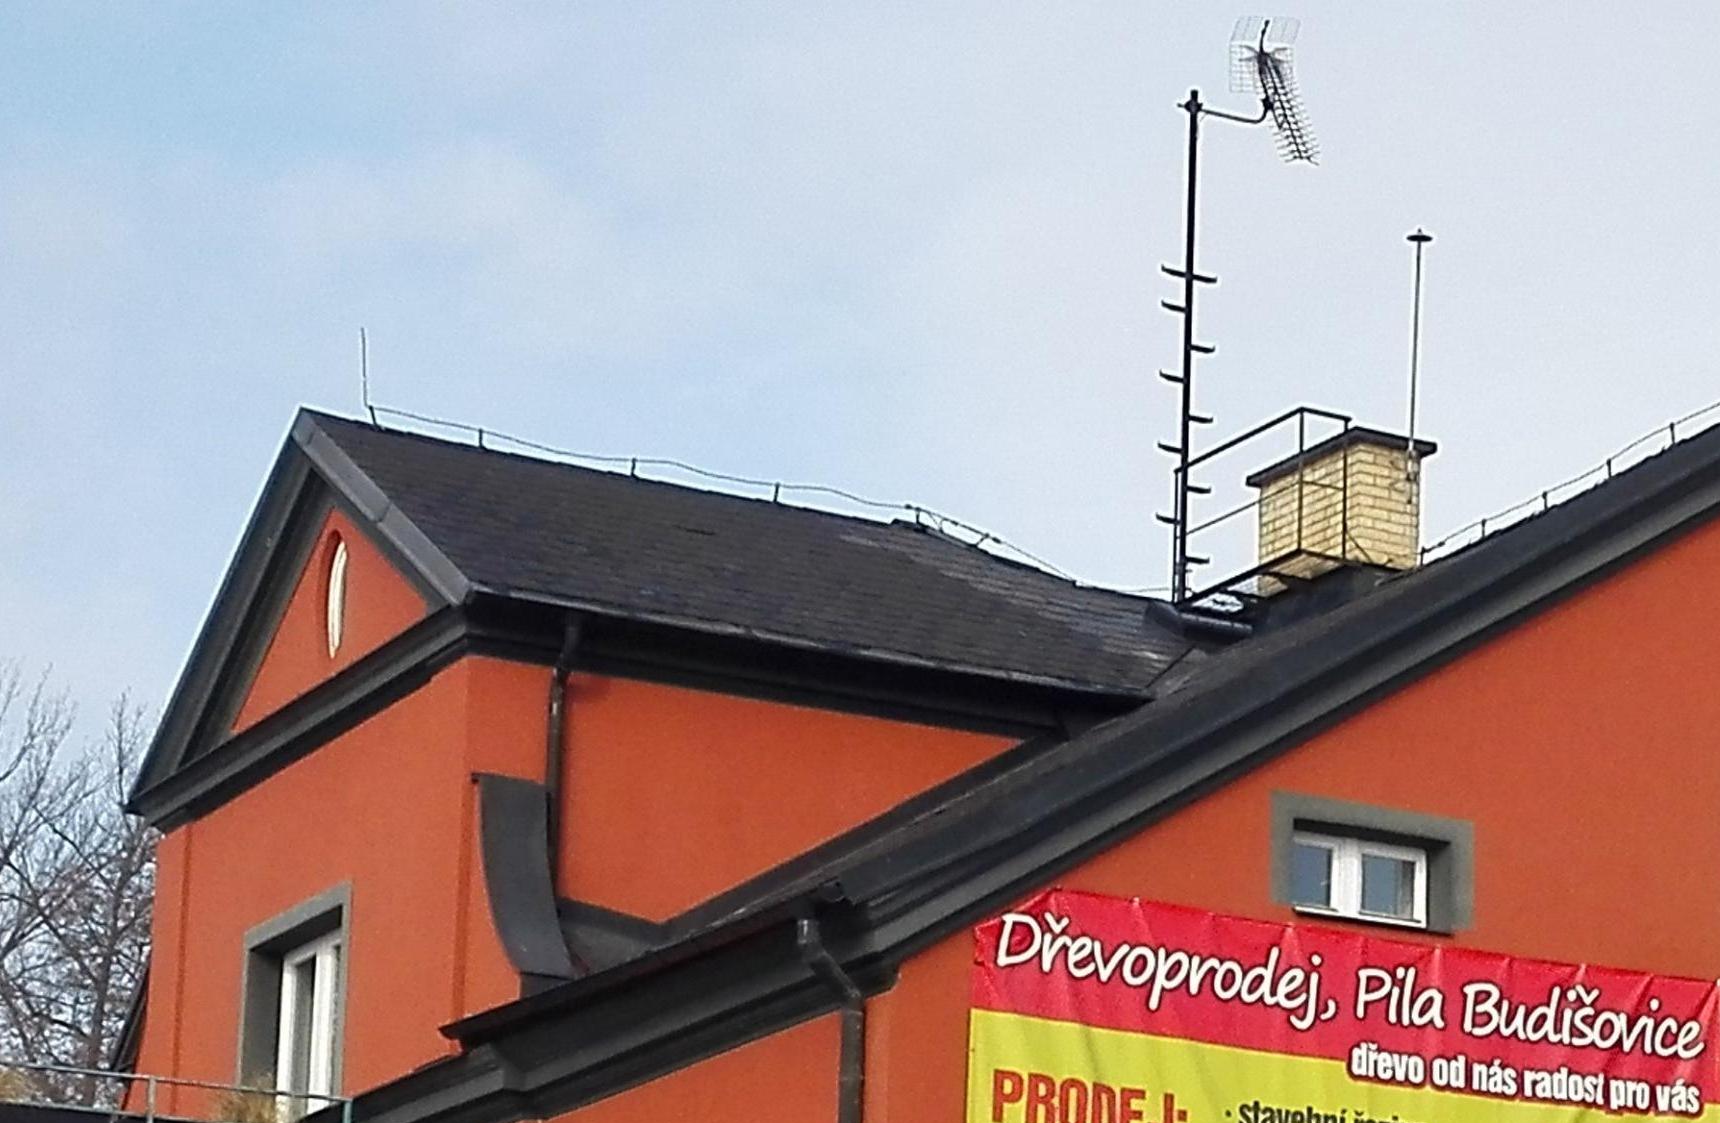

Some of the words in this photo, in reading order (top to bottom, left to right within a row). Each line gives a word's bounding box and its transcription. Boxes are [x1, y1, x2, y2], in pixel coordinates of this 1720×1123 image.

[996, 911, 1338, 1030] Dřevoprodej,
[1355, 966, 1445, 1030] Pila
[1462, 982, 1705, 1060] Budišovice
[1350, 1042, 1425, 1084] dřevo
[1432, 1055, 1466, 1089] od
[1472, 1060, 1518, 1096] nás
[1523, 1067, 1605, 1106] radost
[1609, 1080, 1650, 1113] pro
[1655, 1082, 1701, 1115] vás
